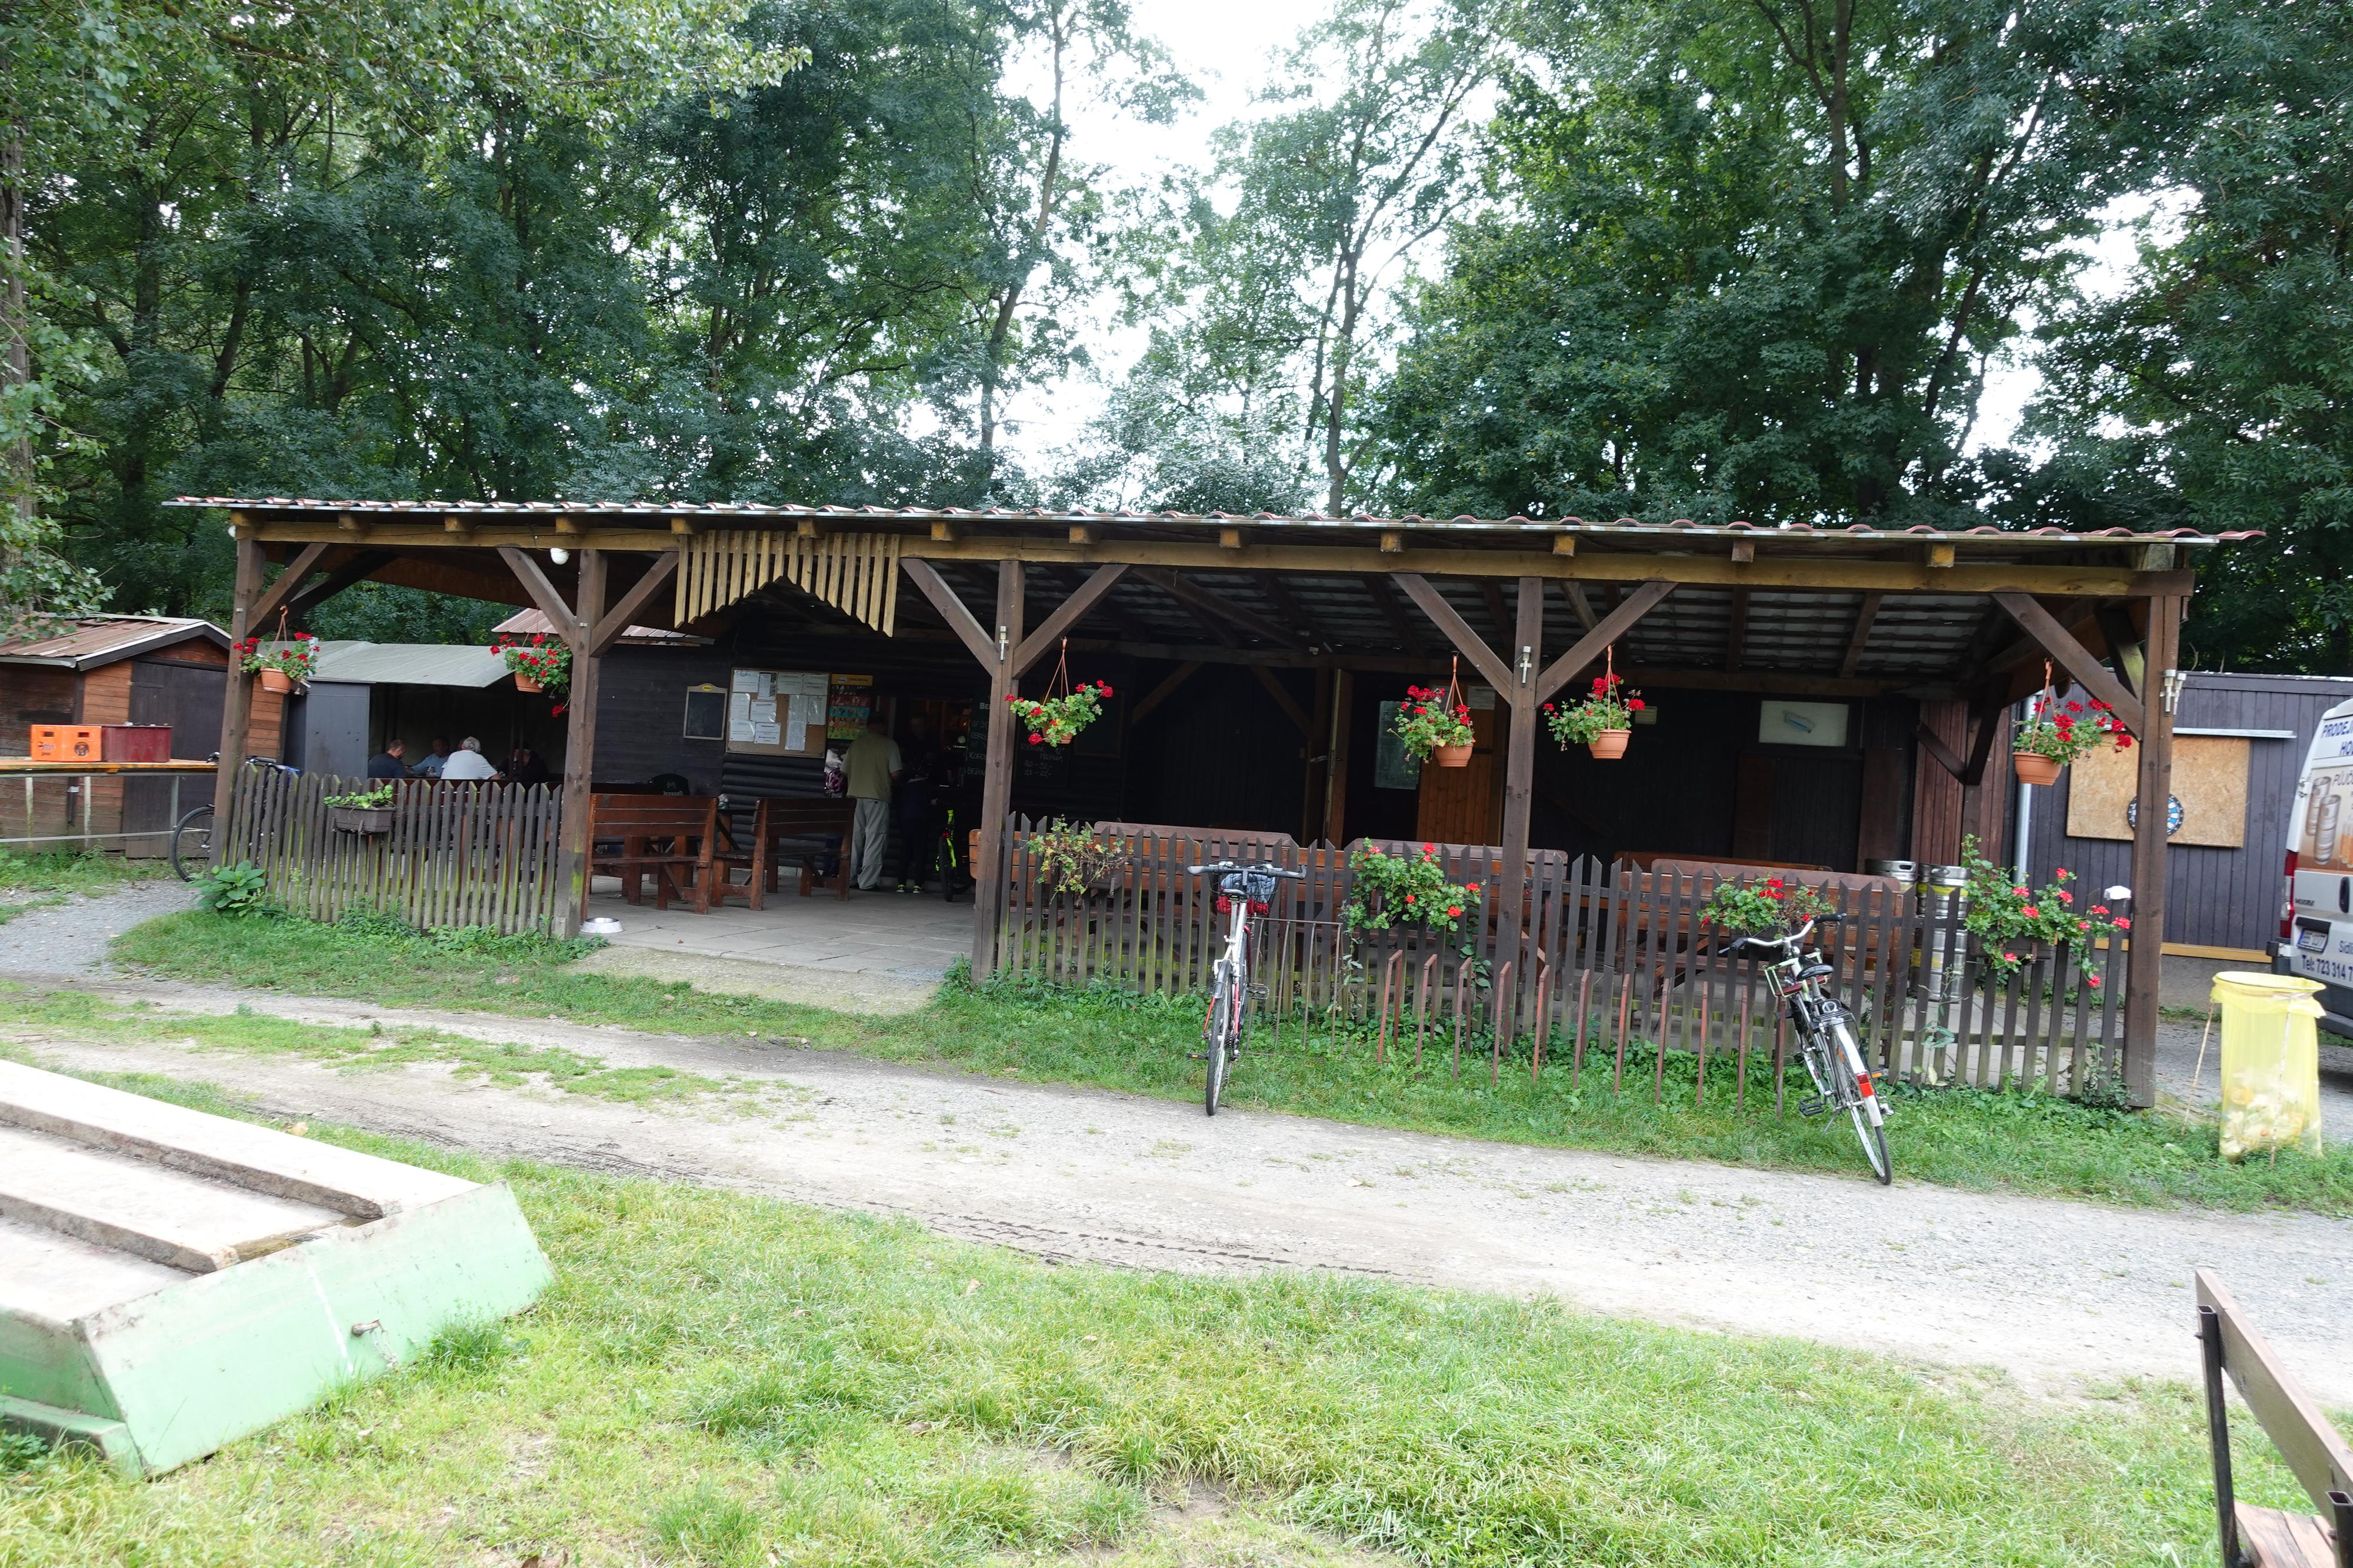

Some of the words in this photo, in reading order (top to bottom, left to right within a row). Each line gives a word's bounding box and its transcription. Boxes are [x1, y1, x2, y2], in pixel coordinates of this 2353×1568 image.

[969, 752, 986, 760] KOFO
[2301, 955, 2314, 972] Tel:
[2317, 958, 2330, 976] 723
[2332, 962, 2345, 980] 314
